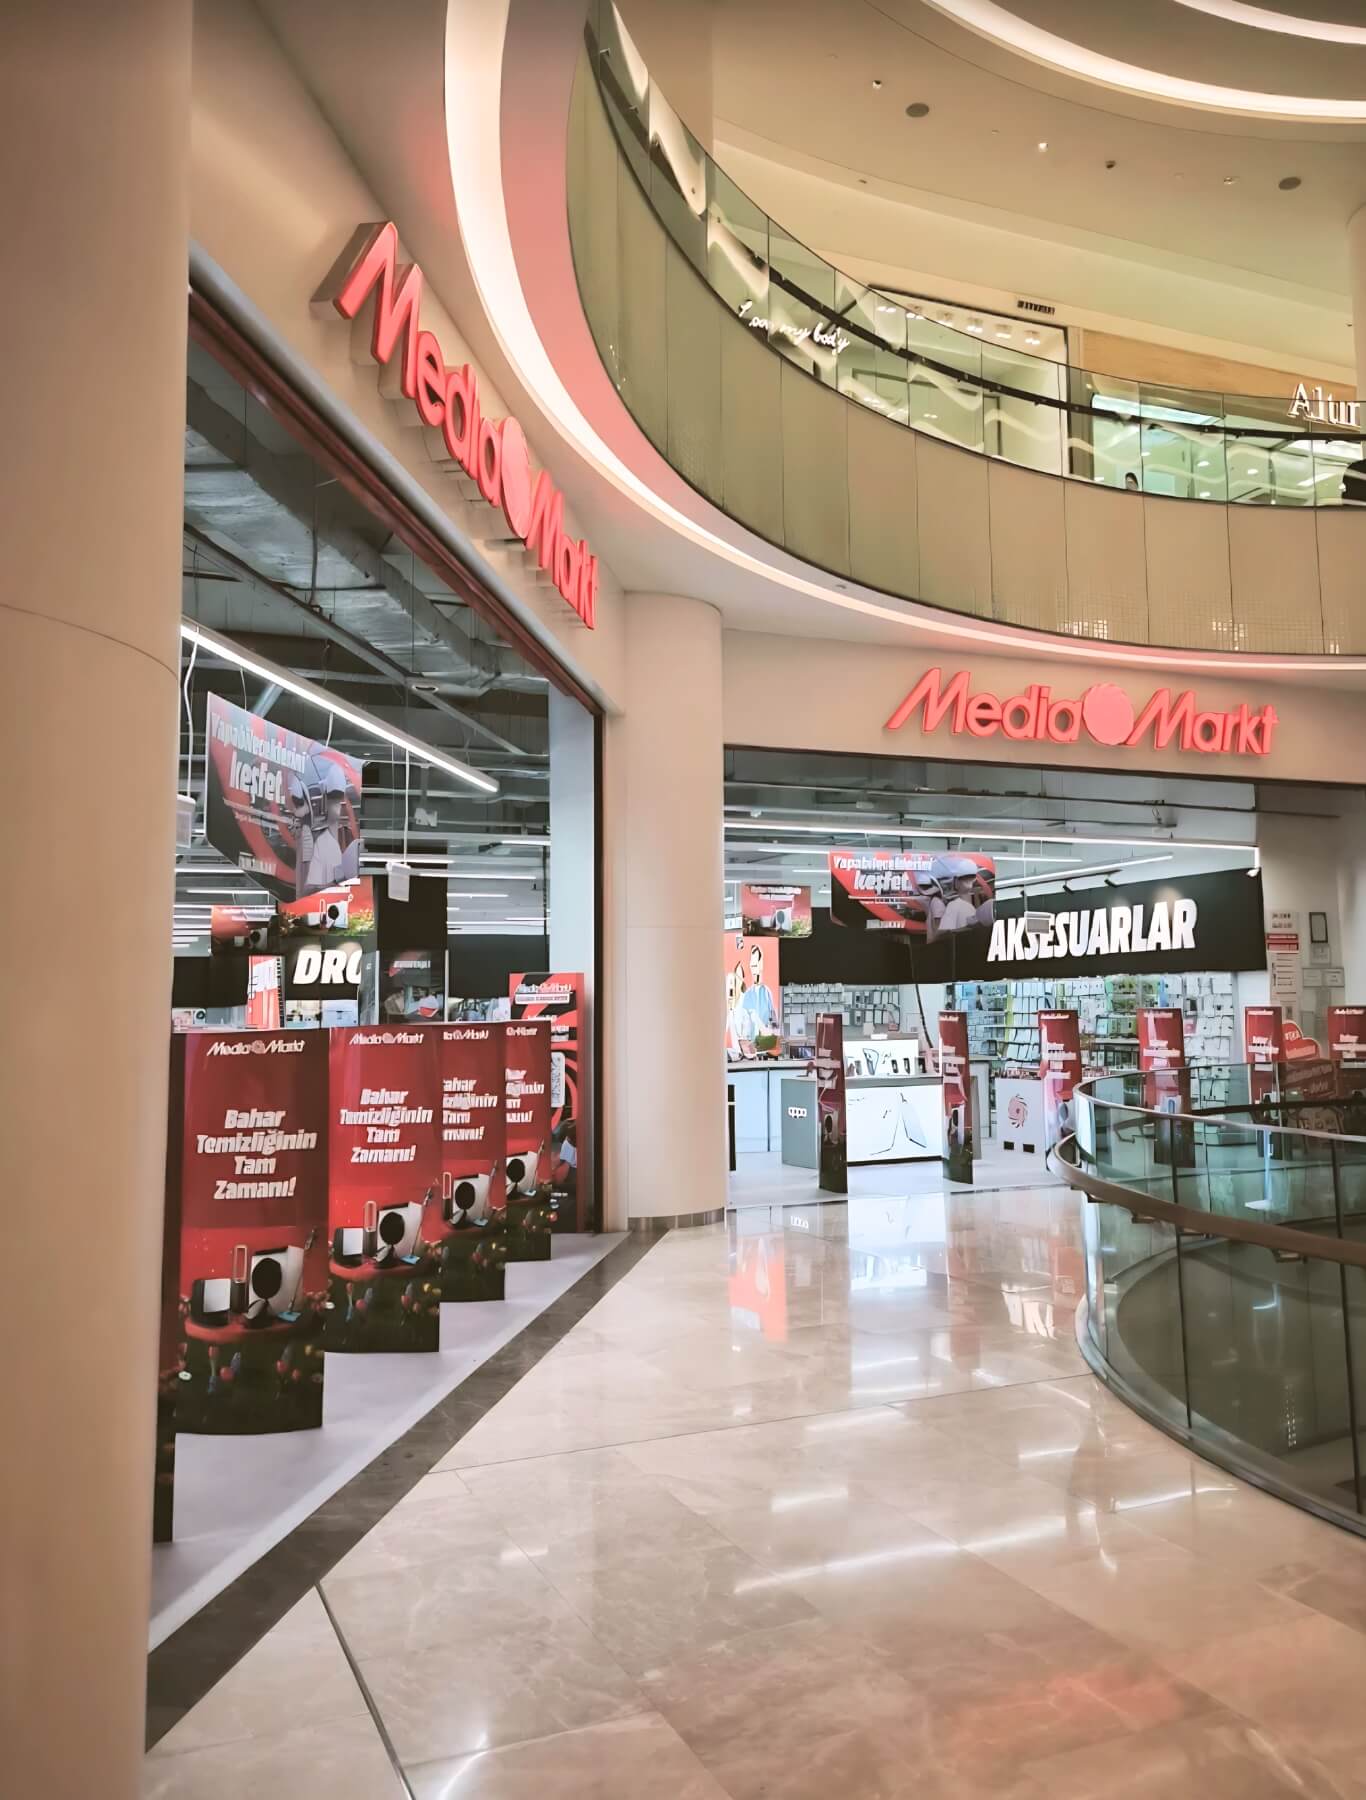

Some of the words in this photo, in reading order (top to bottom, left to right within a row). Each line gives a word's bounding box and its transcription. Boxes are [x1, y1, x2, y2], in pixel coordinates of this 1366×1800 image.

[882, 666, 1081, 744] Media
[1124, 687, 1279, 755] Markt
[987, 899, 1197, 962] AKSESUARLAR
[224, 1108, 286, 1129] Bahar
[197, 1129, 317, 1155] Temizliğinin
[234, 1156, 276, 1175] Tam
[213, 1177, 297, 1199] Zamanı!
